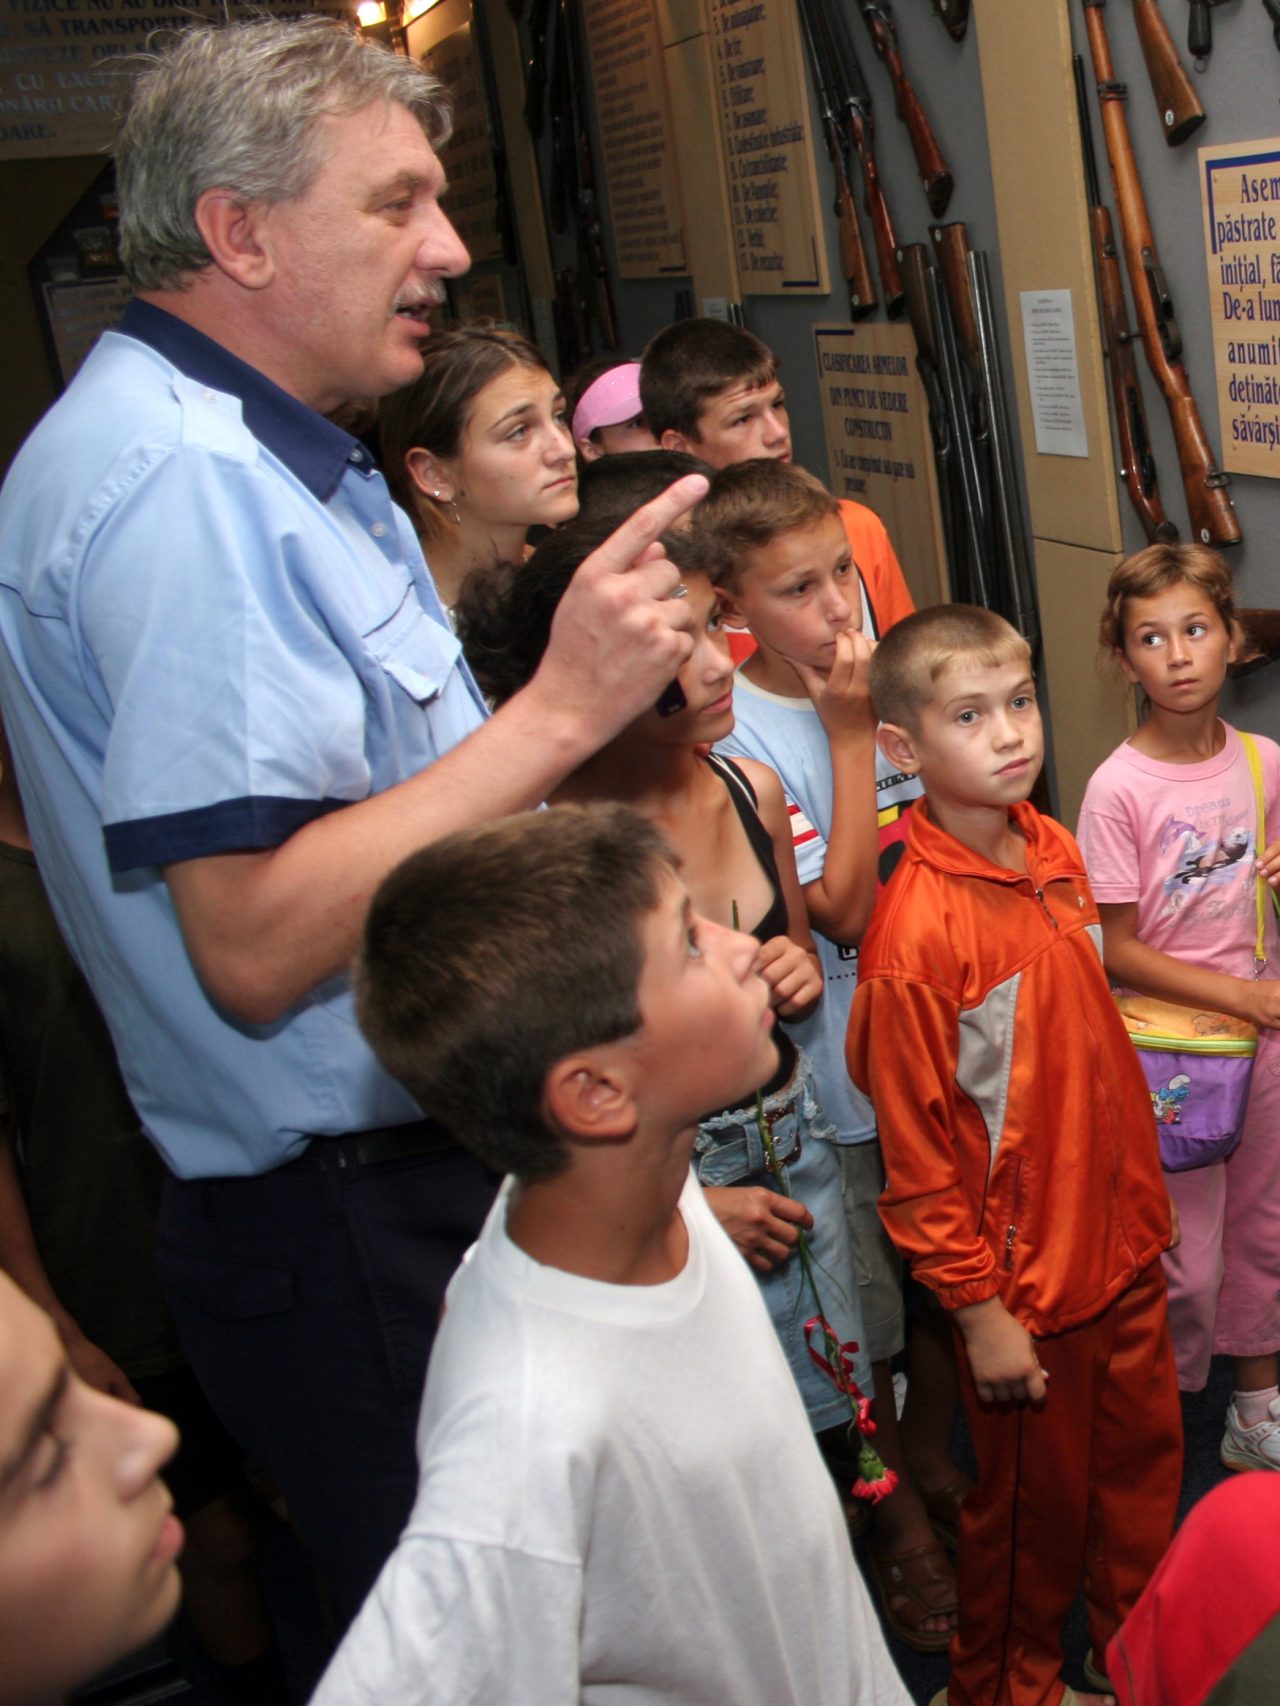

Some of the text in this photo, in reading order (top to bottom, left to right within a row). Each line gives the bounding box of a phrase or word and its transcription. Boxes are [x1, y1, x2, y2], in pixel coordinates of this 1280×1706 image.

[1217, 213, 1276, 251] păstrate
[1221, 256, 1266, 290] inițial,
[1223, 292, 1255, 320] De-a
